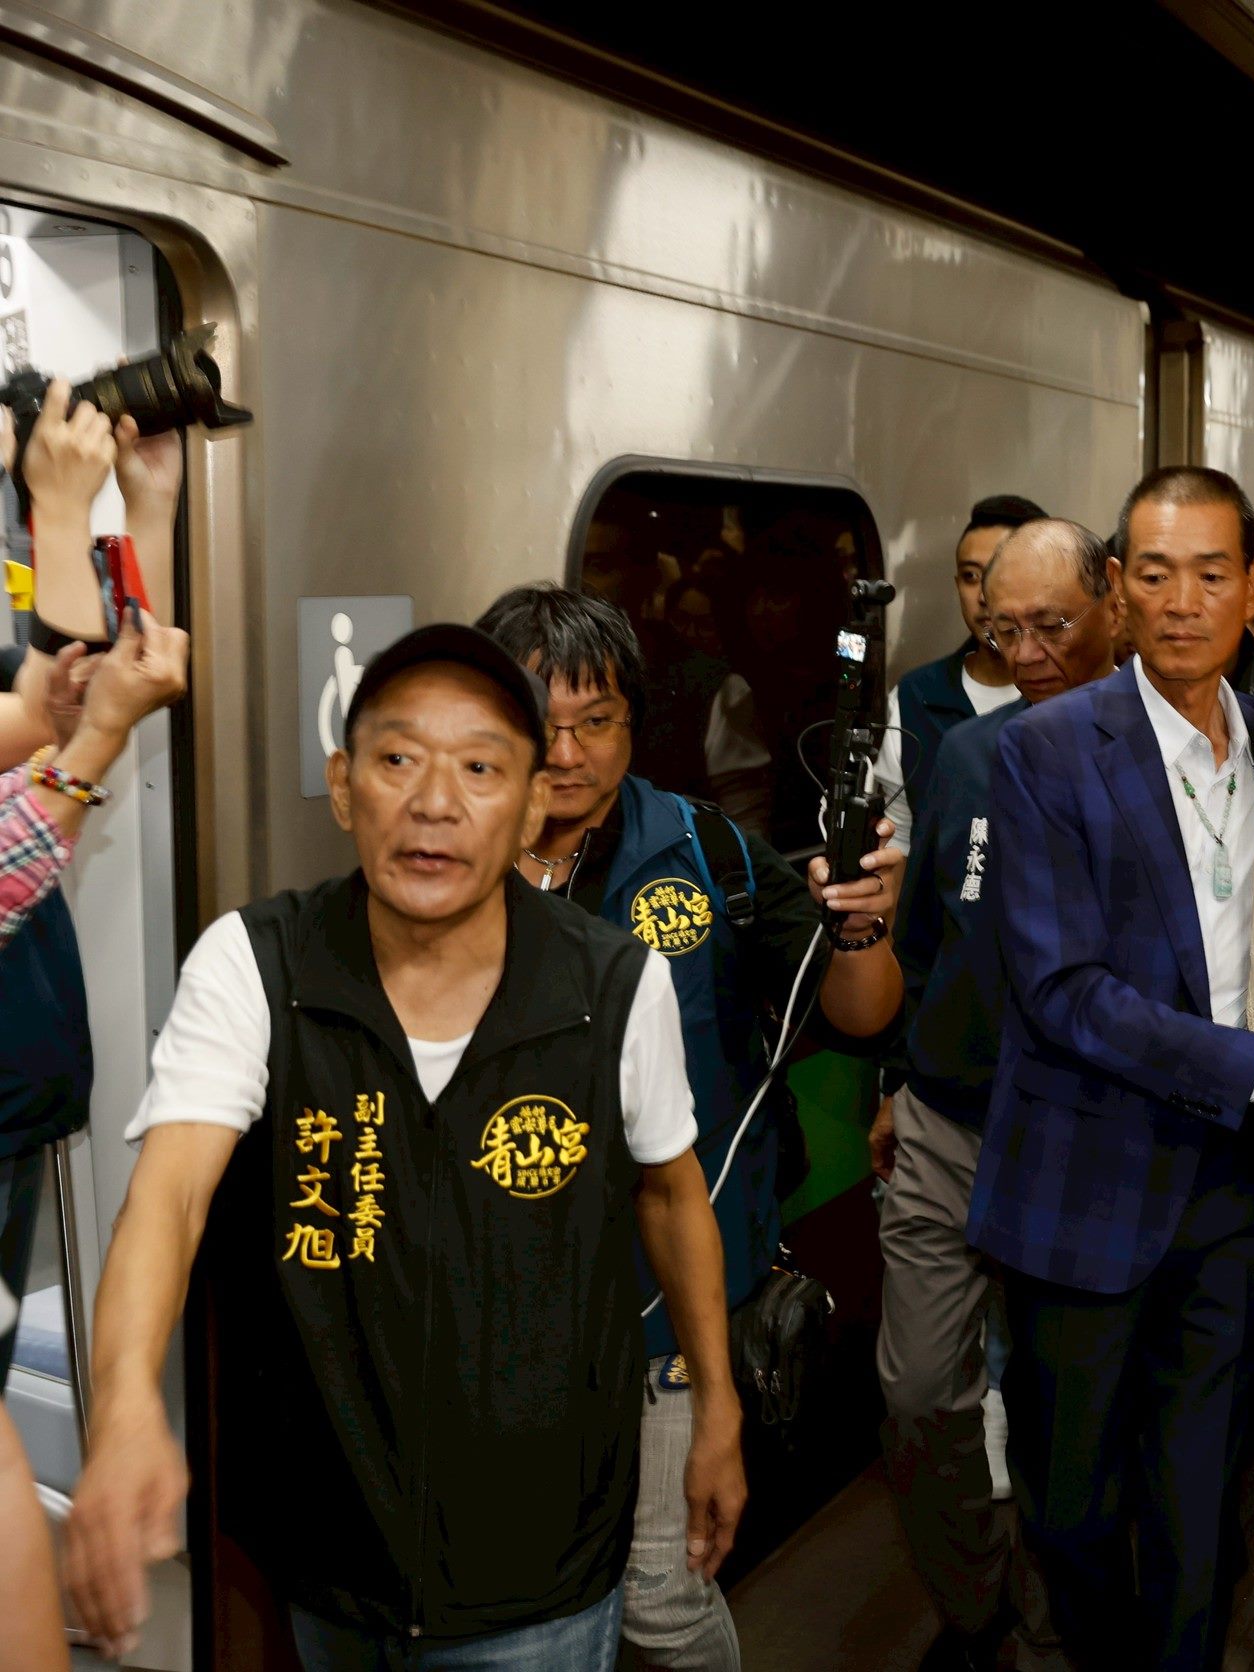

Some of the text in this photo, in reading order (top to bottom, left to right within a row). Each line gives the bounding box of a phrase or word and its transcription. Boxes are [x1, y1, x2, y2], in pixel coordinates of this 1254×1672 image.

[632, 891, 713, 949] 青山宮
[282, 1107, 343, 1270] 許文旭
[348, 1091, 386, 1263] 副主任委員
[470, 1116, 590, 1188] 青山宮
